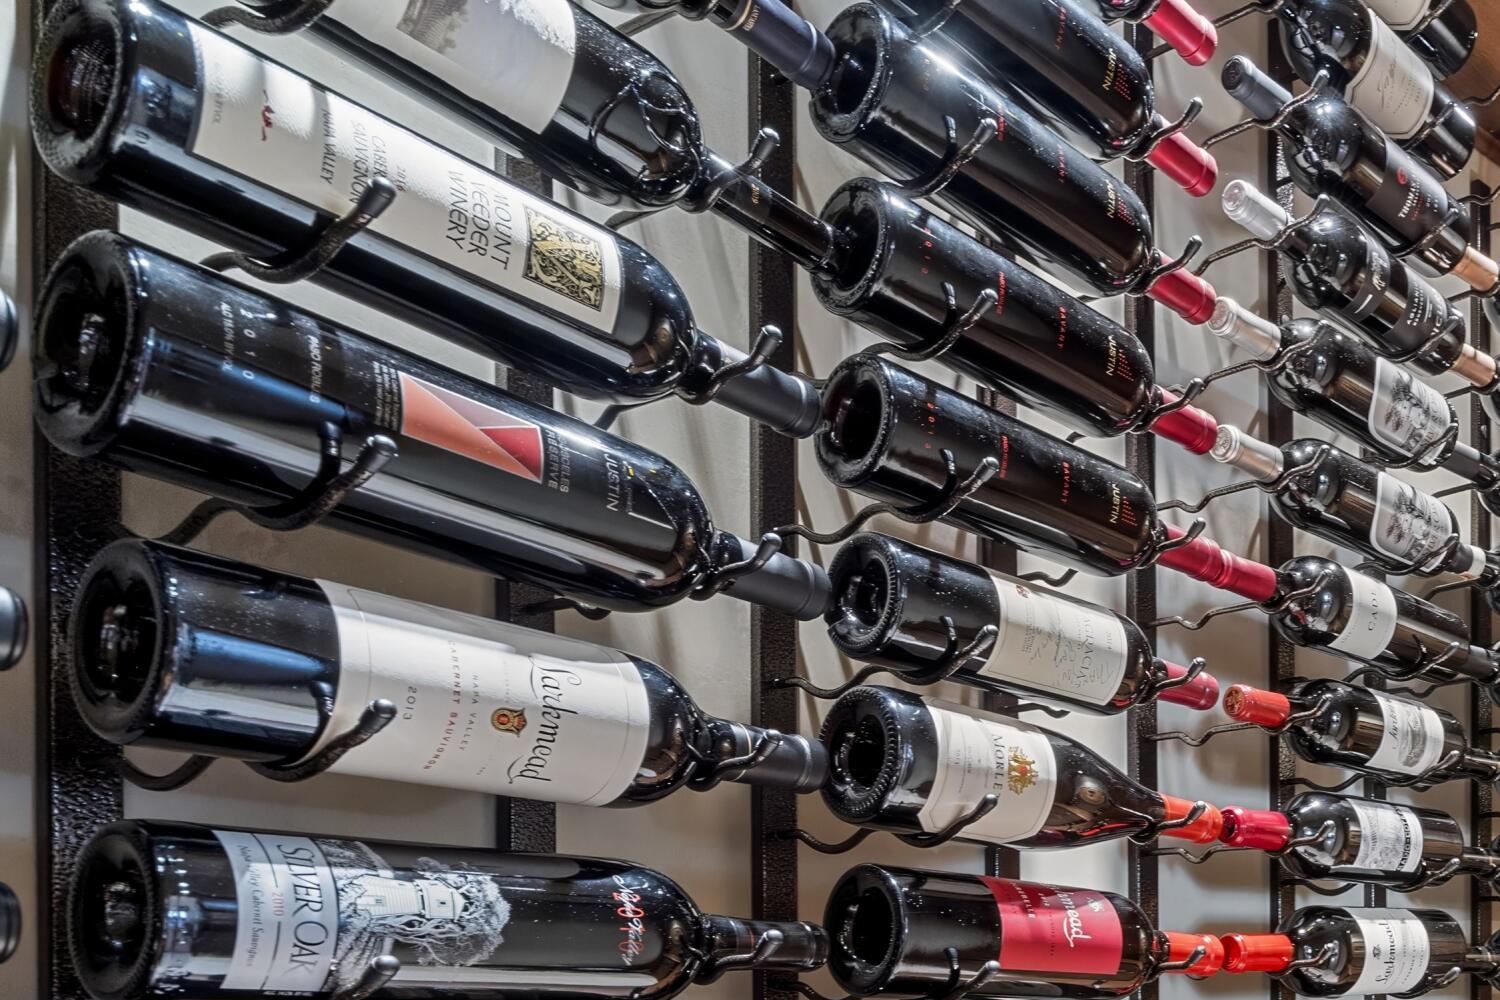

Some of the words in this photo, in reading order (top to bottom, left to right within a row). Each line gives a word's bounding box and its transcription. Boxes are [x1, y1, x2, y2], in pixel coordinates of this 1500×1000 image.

[321, 107, 336, 140] NAPA
[320, 143, 337, 185] VALLEY
[446, 170, 469, 250] WINERY
[467, 181, 492, 257] VEEDER
[1106, 179, 1117, 219] JUSTIN
[491, 190, 513, 271] MOUNT
[1105, 335, 1117, 376] JUSTIN
[603, 453, 621, 512] JUSTIN
[1109, 483, 1121, 525] JUSTIN
[448, 640, 462, 705] CABERNET
[402, 685, 418, 721] 2013
[459, 712, 478, 751] VALLEY
[507, 655, 582, 784] Larkmead
[422, 711, 459, 771] SAUVIGNON
[991, 734, 1006, 798] MORLE
[271, 890, 285, 917] 2010
[276, 843, 325, 918] SILVER
[280, 920, 329, 977] OAK
